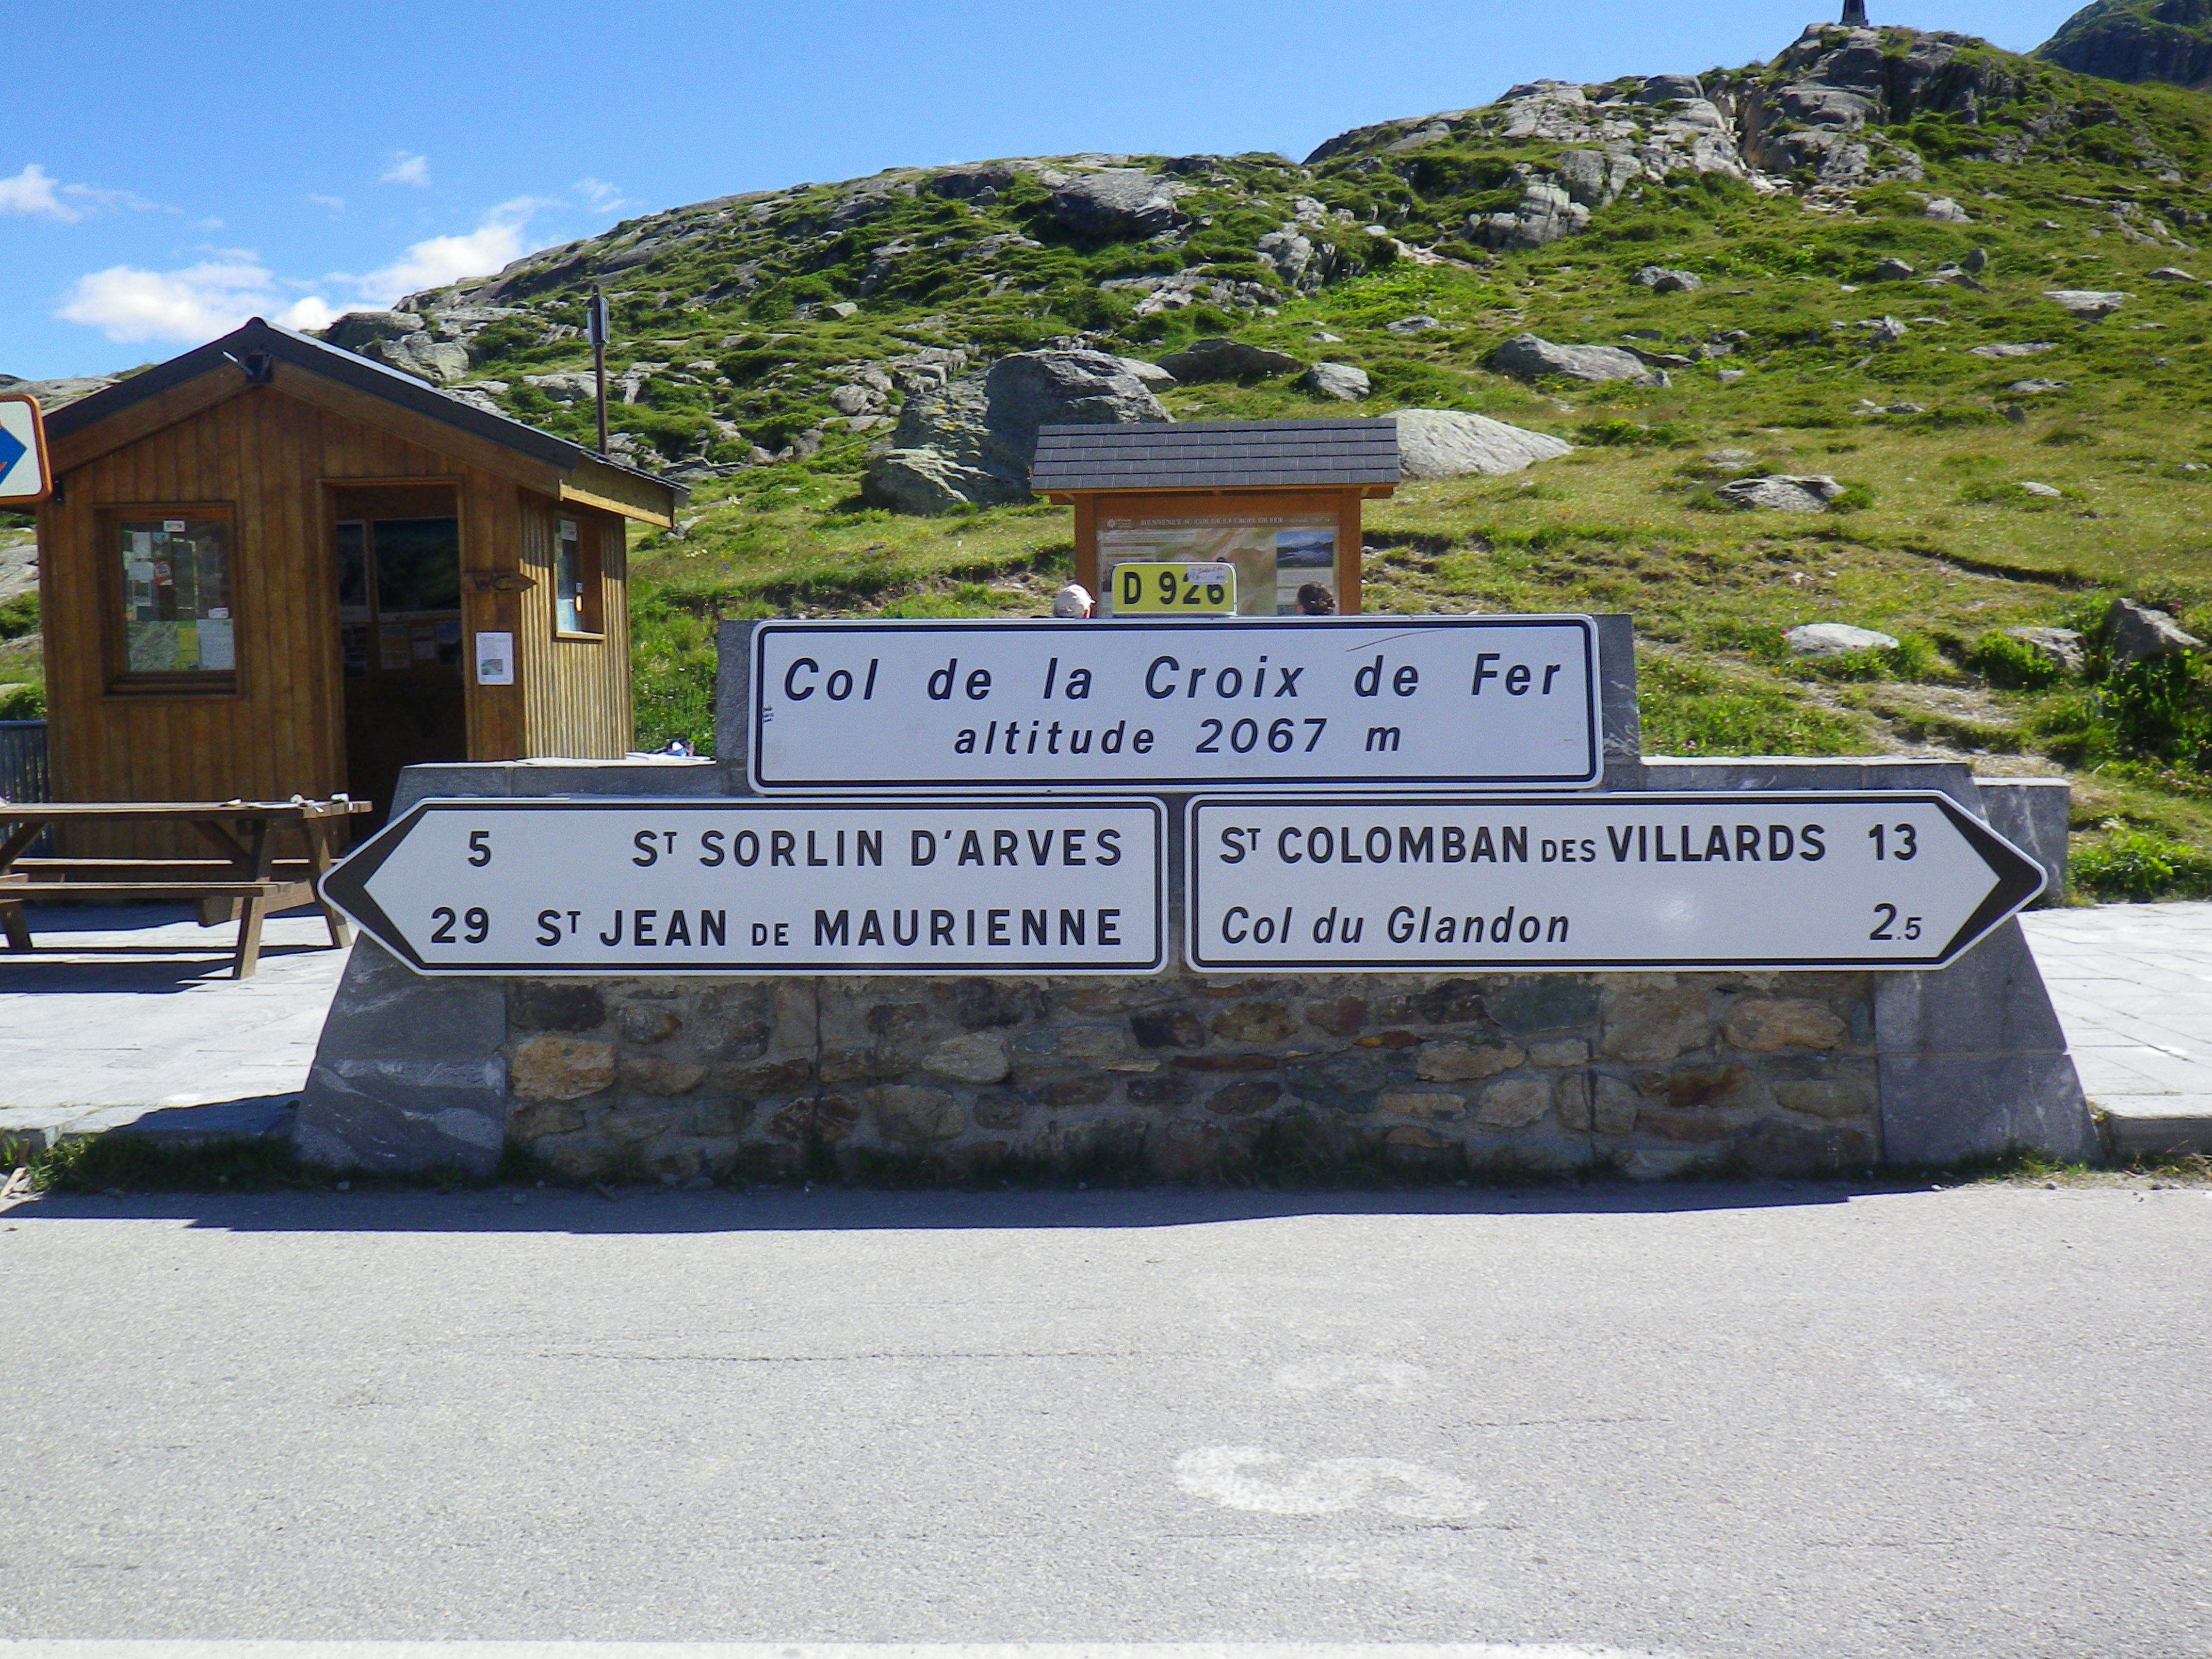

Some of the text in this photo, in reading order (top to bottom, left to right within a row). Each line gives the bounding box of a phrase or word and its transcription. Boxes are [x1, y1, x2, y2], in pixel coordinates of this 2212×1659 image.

[473, 573, 512, 591] WC
[1124, 571, 1225, 605] D 926
[784, 653, 1561, 701] Col de la Croix de Fer
[954, 718, 1401, 755] altitude 2067 m
[468, 831, 492, 868] 5
[700, 830, 882, 867] SORLIN
[912, 828, 1121, 866] D'ARVES
[1278, 826, 1527, 864] COLOMBAN
[1541, 839, 1596, 863] DES
[1606, 824, 1826, 863] VILLARDS
[1868, 823, 1917, 861] 13
[431, 906, 489, 944] 29
[599, 909, 726, 947] JEAN
[752, 923, 789, 946] DE
[815, 908, 1121, 947] MAURIENNE
[1222, 903, 1922, 944] Col du Glandon 2.5
